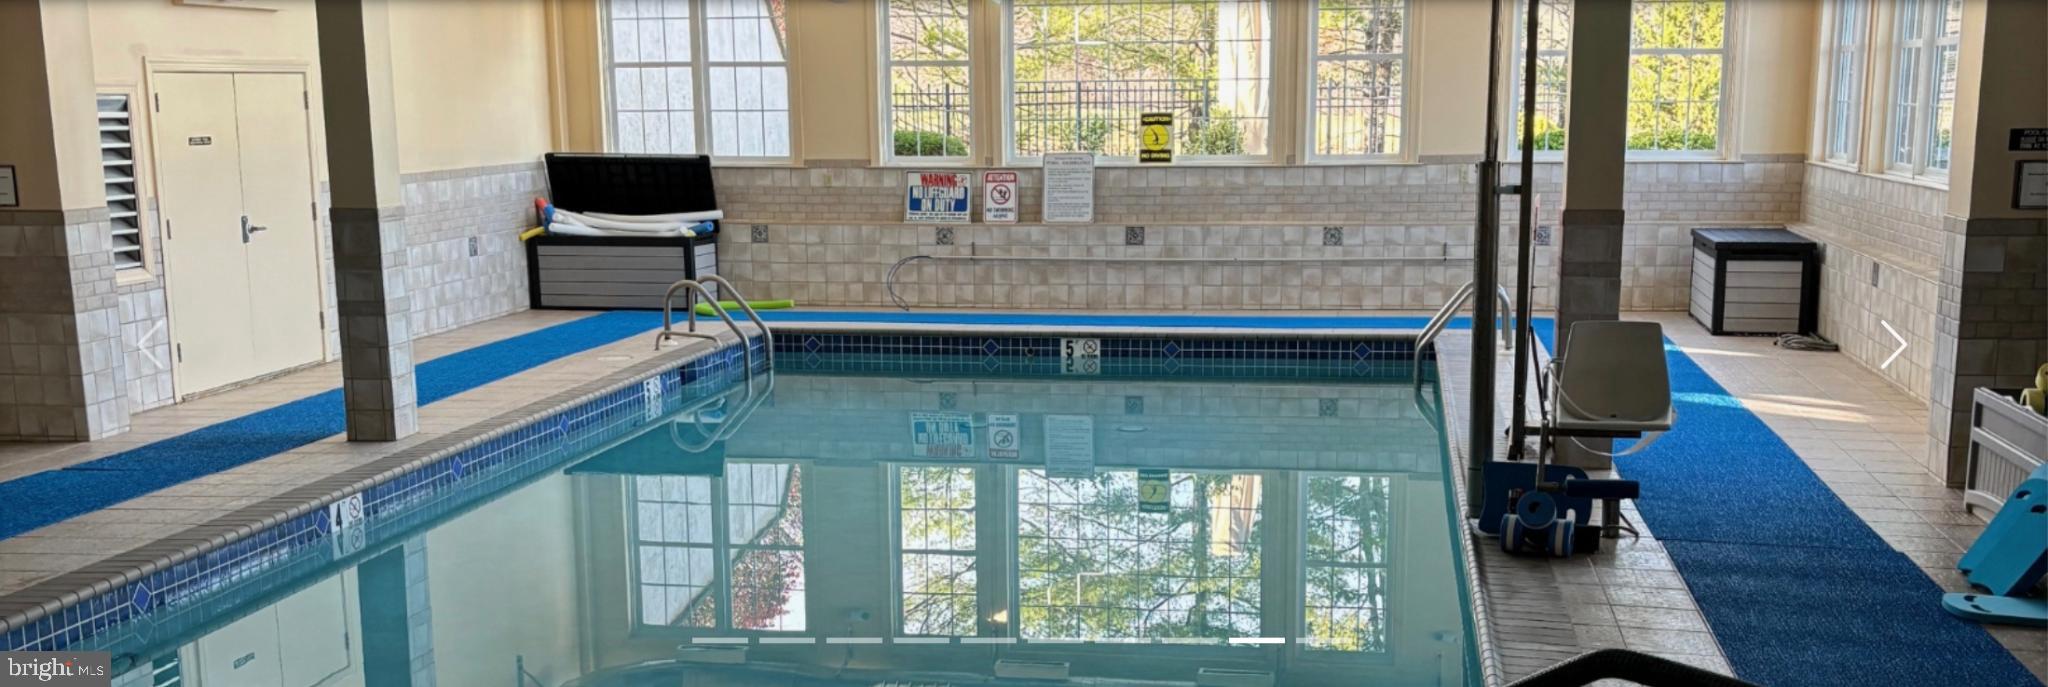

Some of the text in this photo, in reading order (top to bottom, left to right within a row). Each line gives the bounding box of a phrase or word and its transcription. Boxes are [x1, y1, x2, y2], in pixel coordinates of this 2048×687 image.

[920, 173, 957, 187] WARNING
[912, 186, 965, 199] NO LIFEGUARD
[921, 198, 955, 212] ON DUTY
